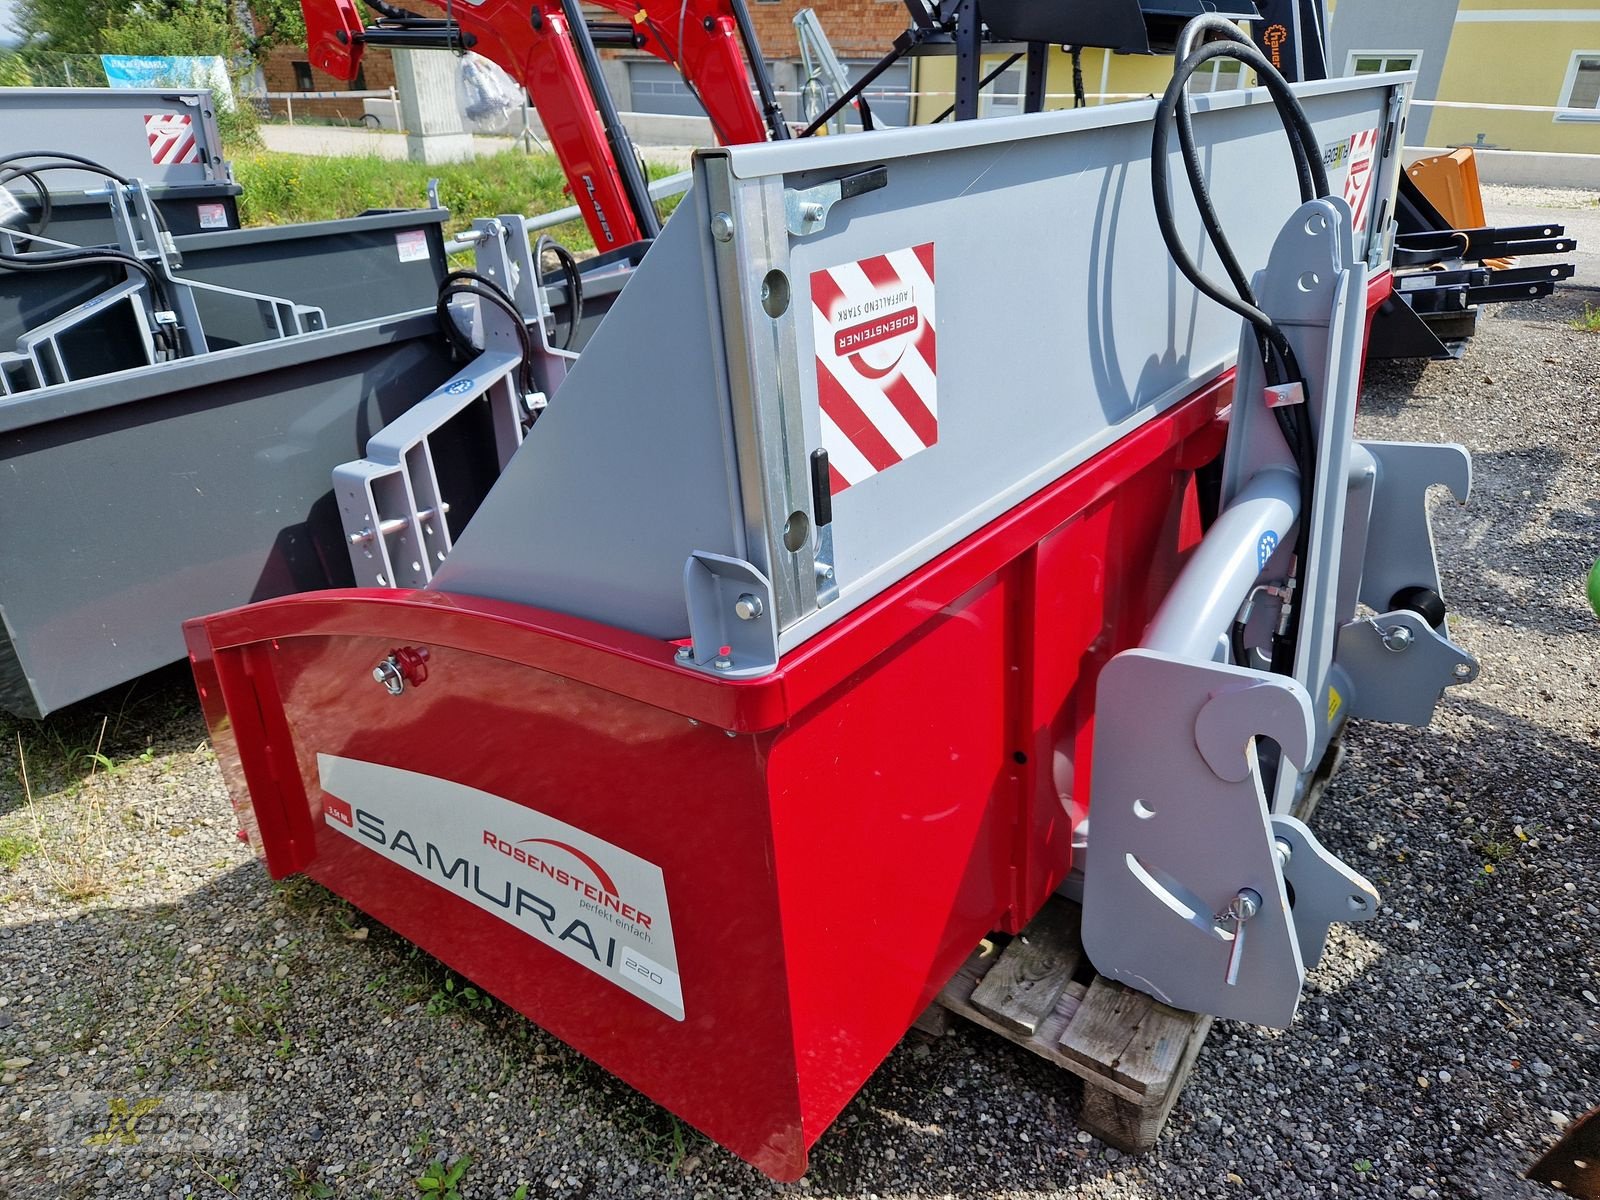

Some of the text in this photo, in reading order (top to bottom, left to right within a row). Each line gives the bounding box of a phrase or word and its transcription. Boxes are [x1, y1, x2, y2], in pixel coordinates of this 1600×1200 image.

[837, 290, 908, 322] AUFFALLEND STARK
[839, 313, 915, 348] ROSENSTEINER
[356, 808, 616, 968] SAMURAI
[483, 830, 652, 930] ROSENSTEINER
[579, 899, 654, 945] perfekt einfach.
[625, 957, 663, 985] 220
